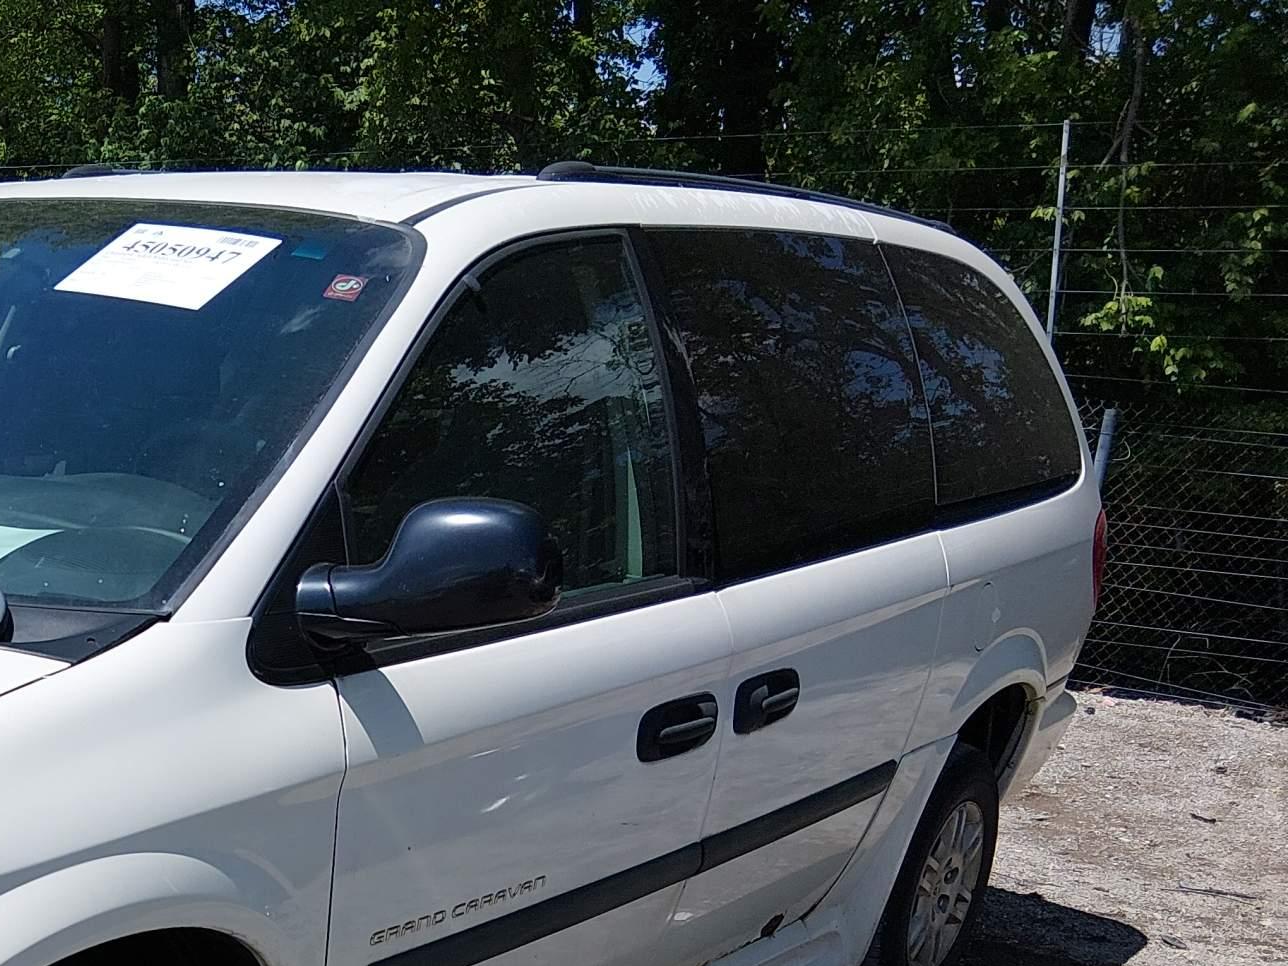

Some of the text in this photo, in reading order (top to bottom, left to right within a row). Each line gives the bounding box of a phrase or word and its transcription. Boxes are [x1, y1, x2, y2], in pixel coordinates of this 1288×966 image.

[123, 240, 242, 264] 45050947
[369, 875, 547, 946] GRAND CARAVAN
